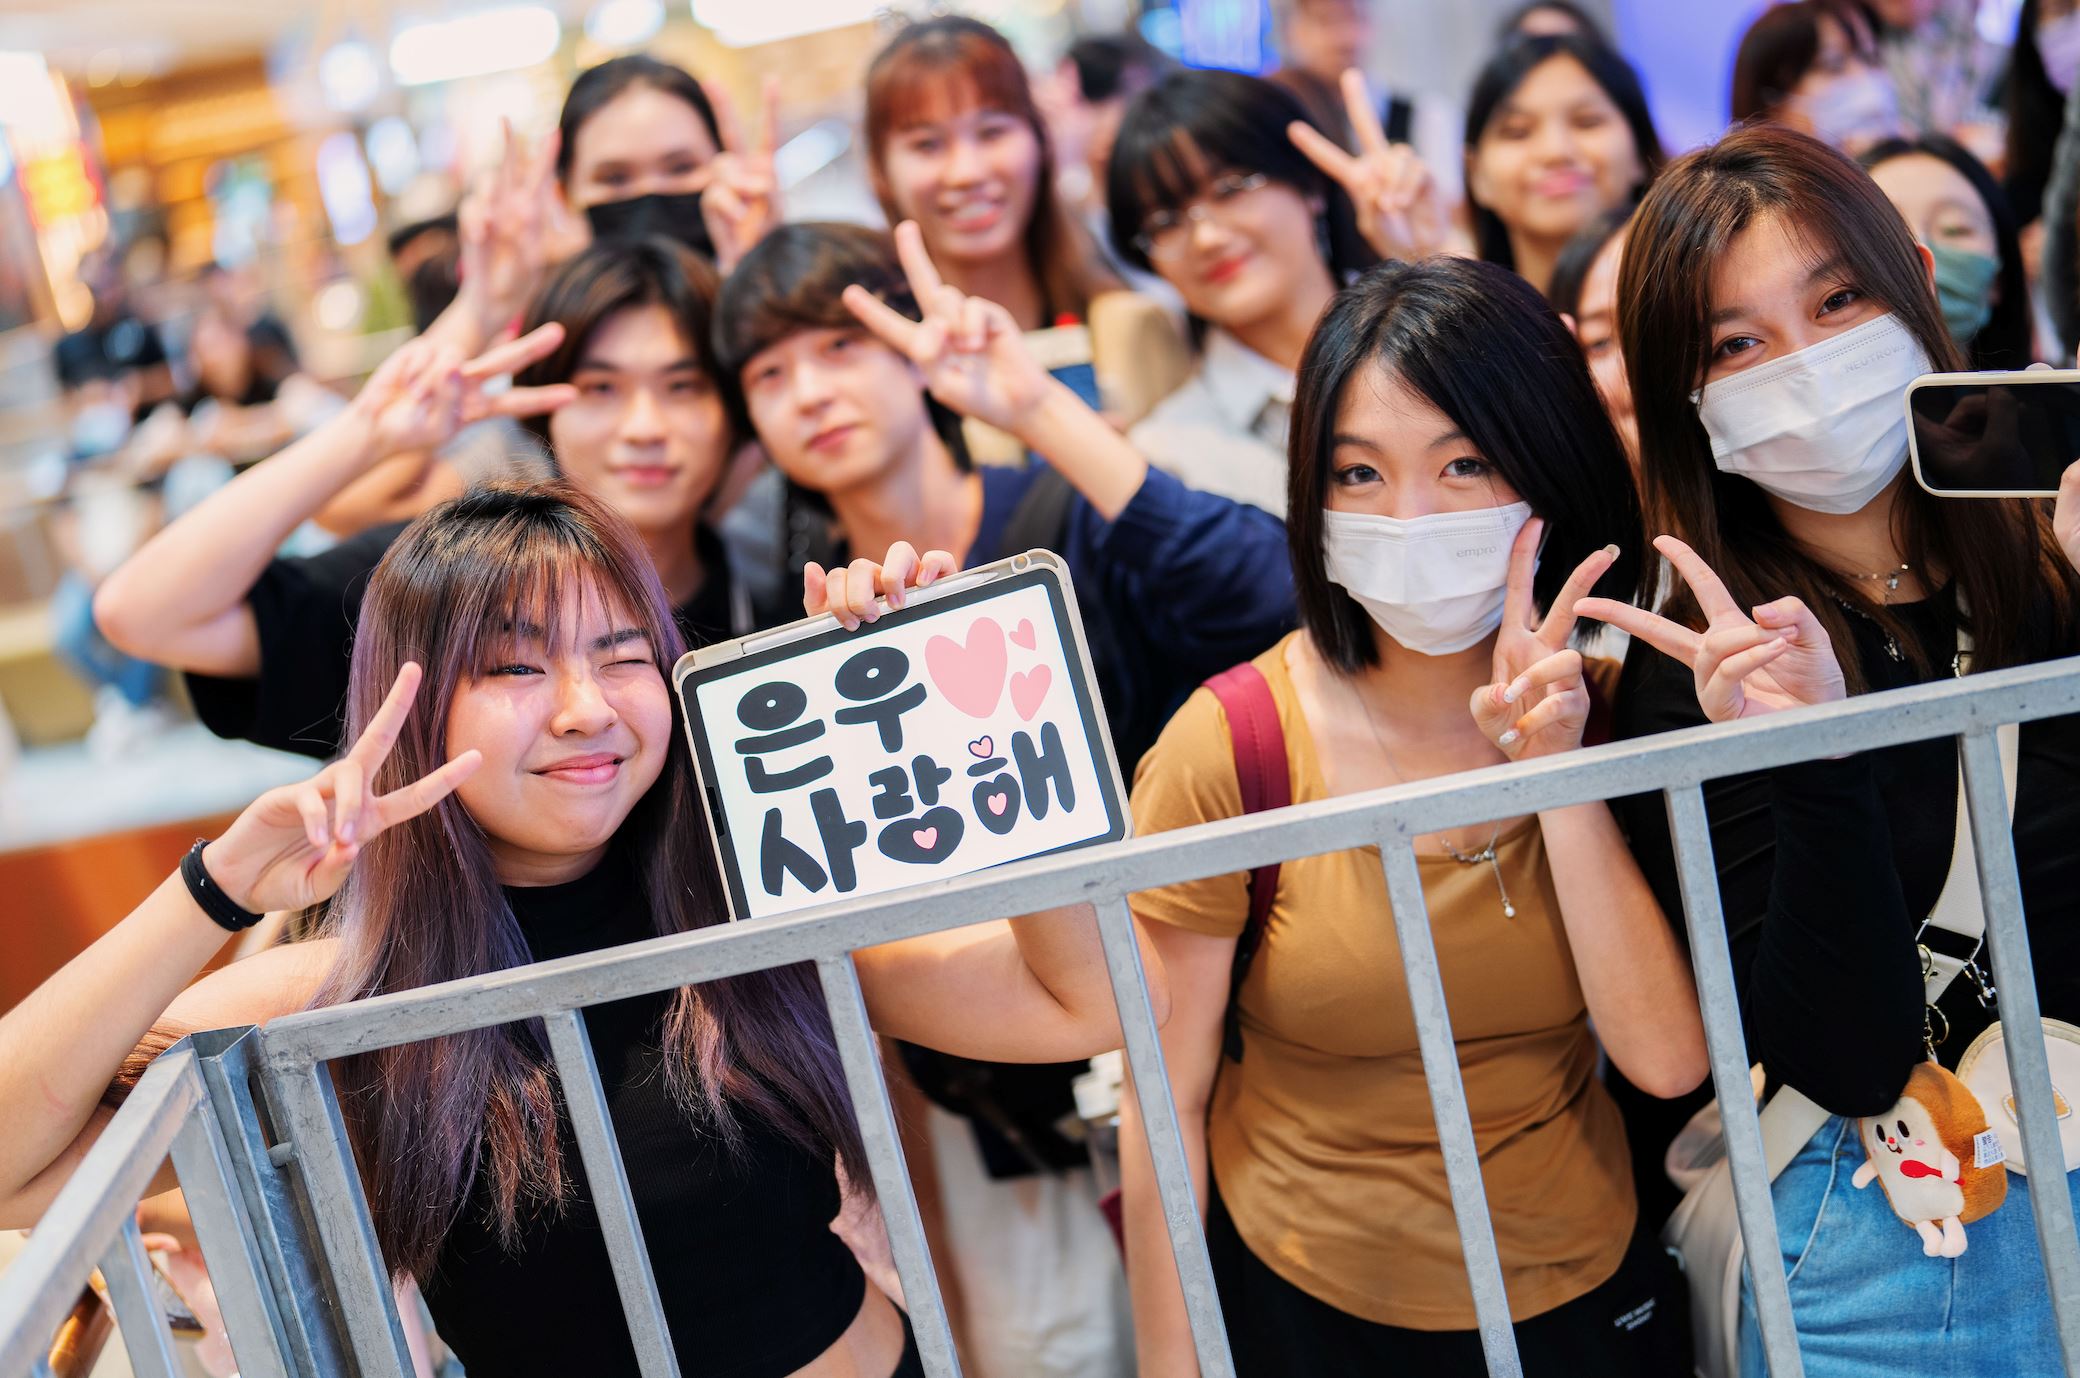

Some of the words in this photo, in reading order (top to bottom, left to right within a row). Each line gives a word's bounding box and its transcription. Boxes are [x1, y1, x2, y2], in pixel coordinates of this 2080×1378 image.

[1456, 545, 1497, 559] empro
[734, 646, 928, 794] 은우
[760, 721, 1076, 896] 사랑해
